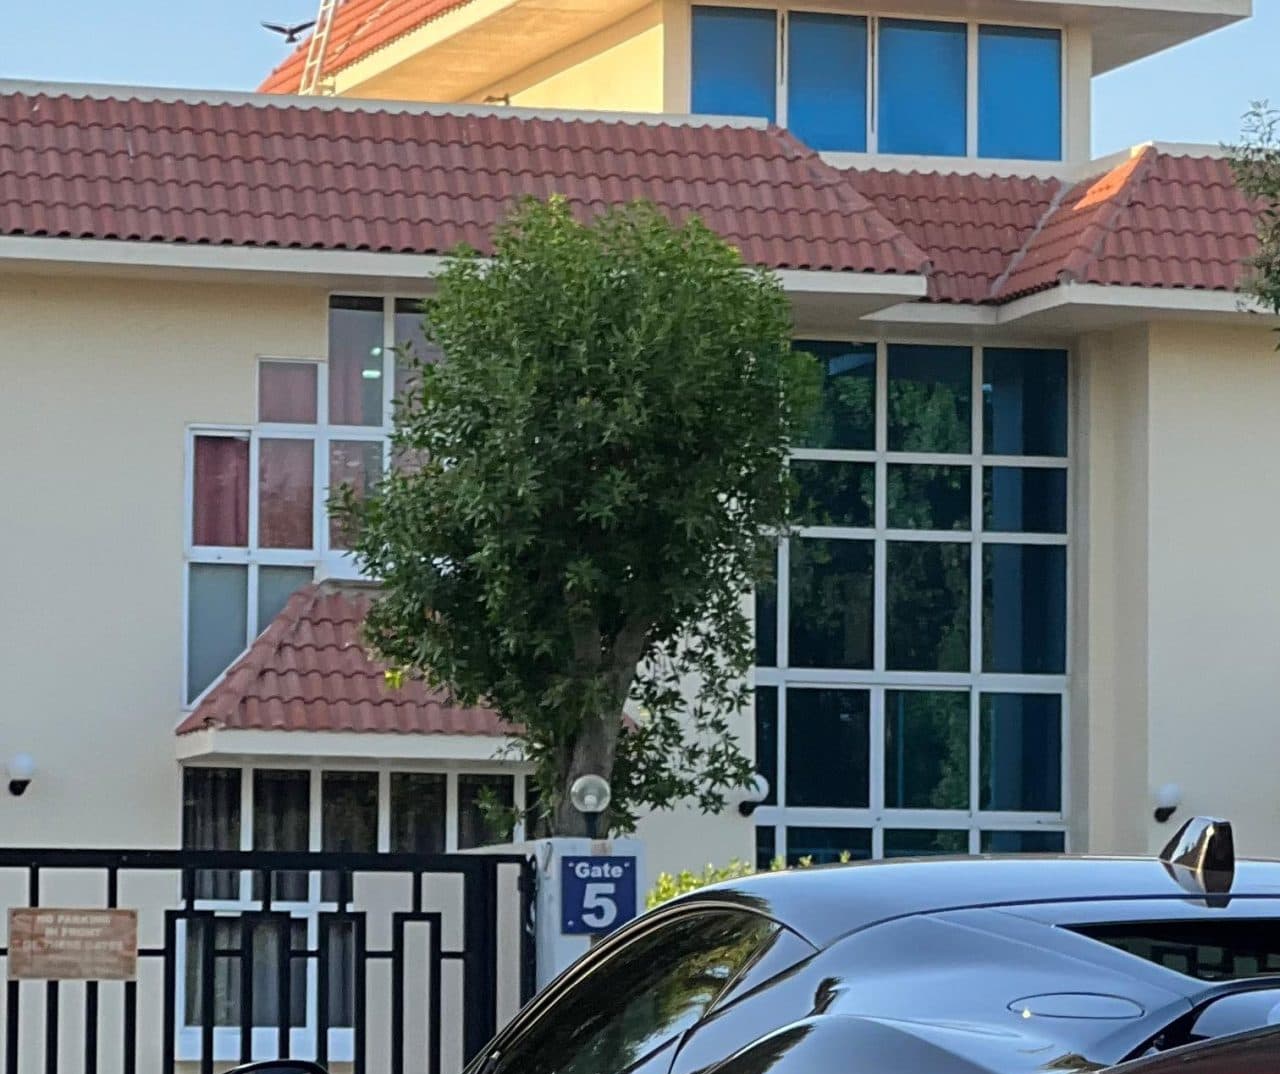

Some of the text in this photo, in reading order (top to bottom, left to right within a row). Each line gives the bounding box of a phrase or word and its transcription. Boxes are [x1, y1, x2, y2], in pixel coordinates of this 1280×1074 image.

[575, 862, 623, 878] Gate
[582, 883, 617, 928] 5
[57, 914, 112, 925] PARKING
